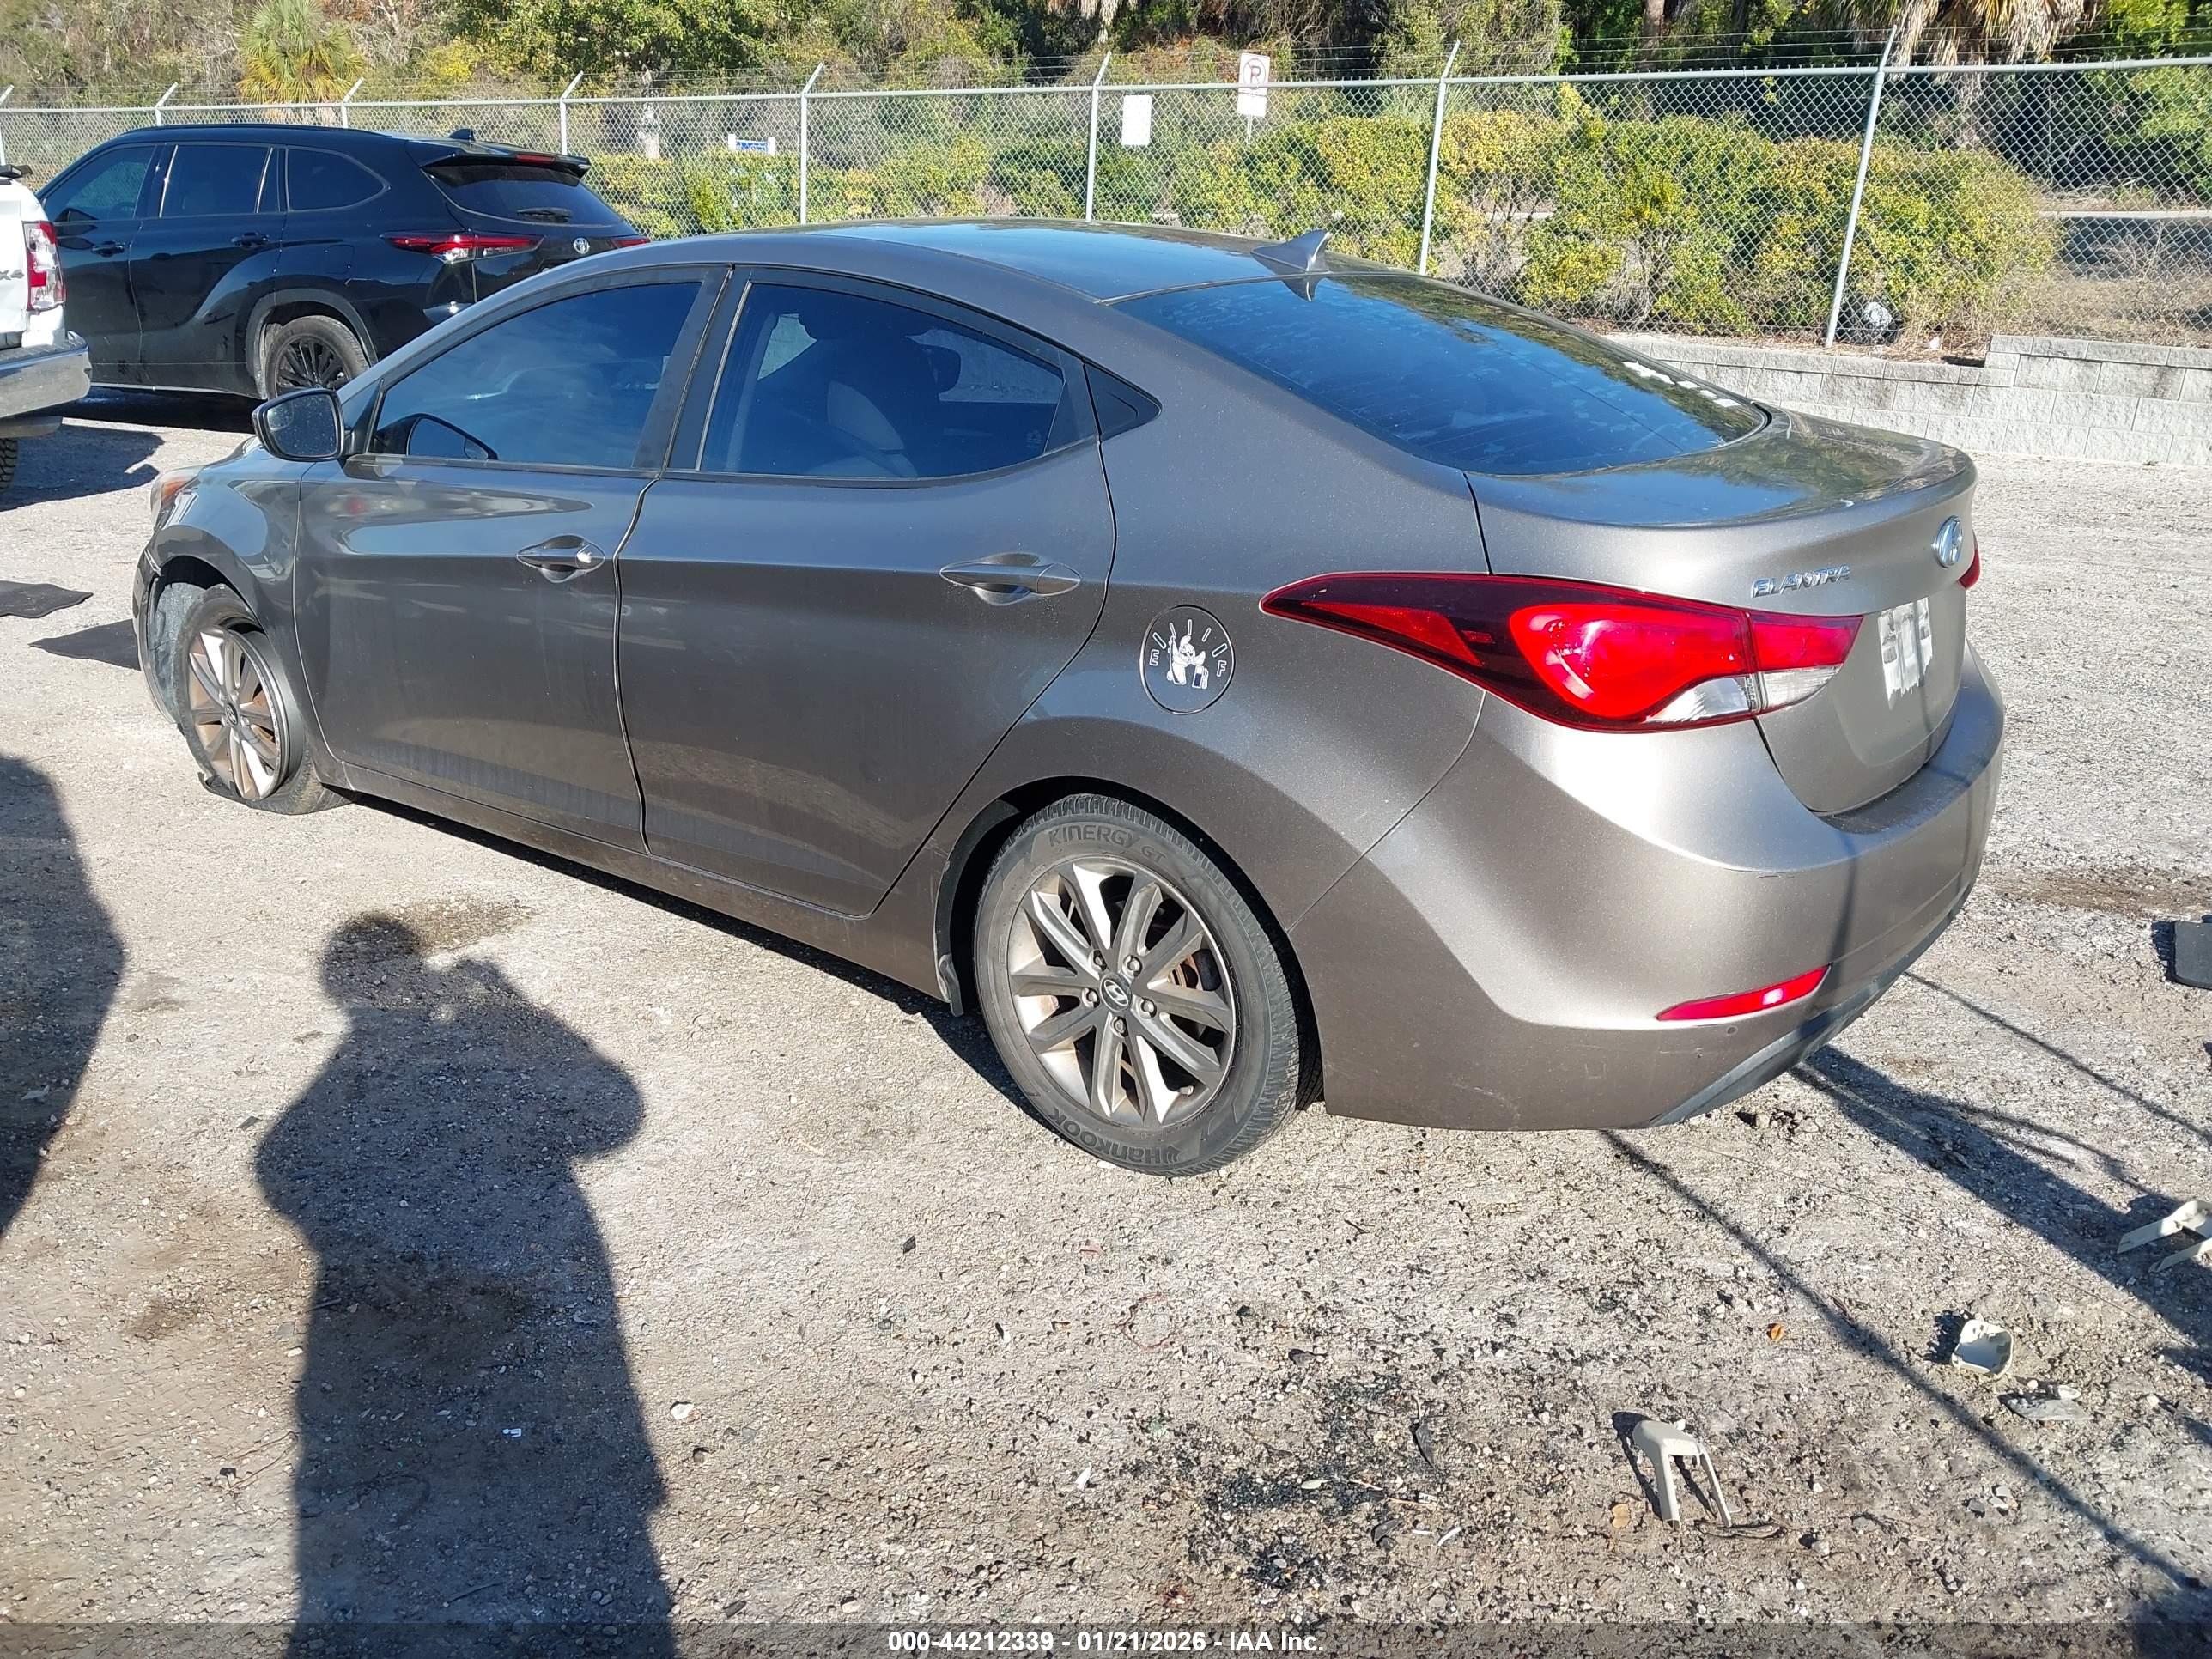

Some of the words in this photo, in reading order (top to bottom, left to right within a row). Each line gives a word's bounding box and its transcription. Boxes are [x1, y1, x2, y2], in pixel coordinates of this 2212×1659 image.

[1751, 563, 1850, 598] ELANTRA
[1150, 649, 1160, 666] E
[1217, 659, 1227, 677] F
[1140, 844, 1166, 862] GT
